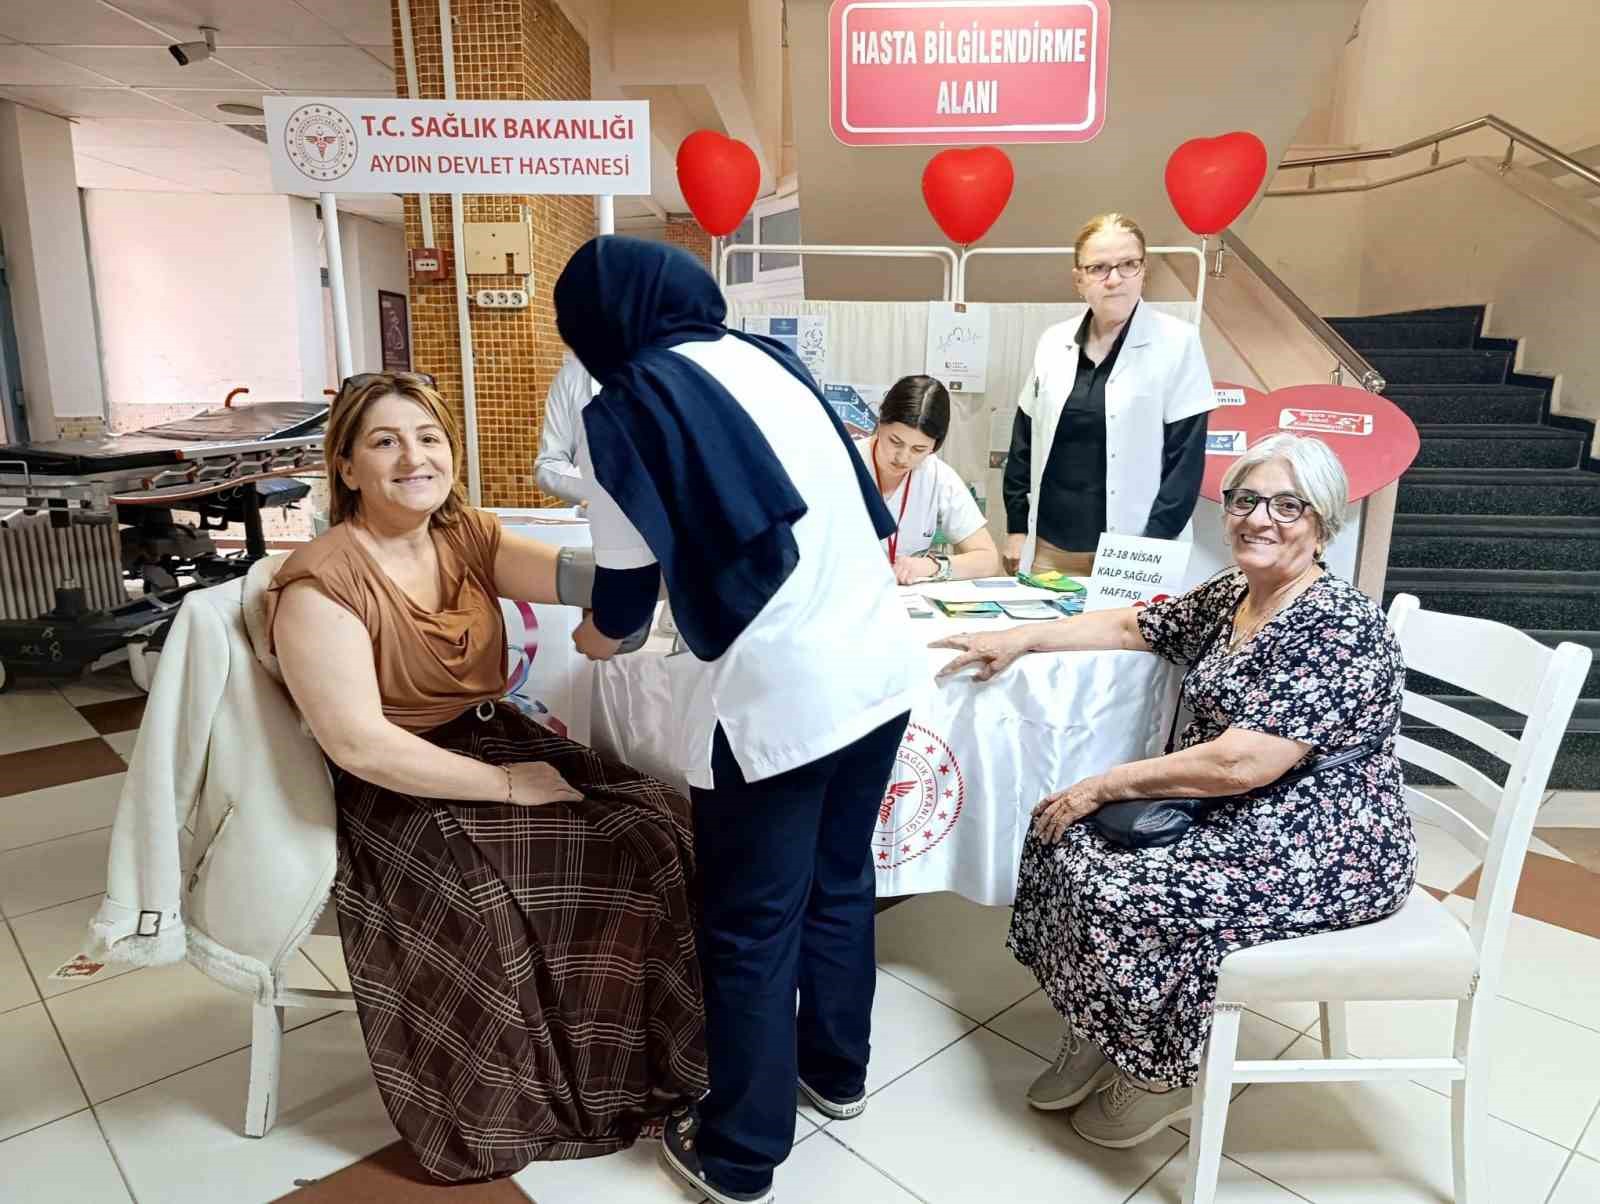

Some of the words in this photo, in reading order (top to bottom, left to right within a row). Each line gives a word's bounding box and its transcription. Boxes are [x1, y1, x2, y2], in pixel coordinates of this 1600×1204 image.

[851, 31, 918, 65] HASTA
[924, 21, 1087, 64] BİLGİLENDİRME
[936, 80, 998, 114] ALANI
[361, 115, 405, 137] T.C.
[411, 113, 497, 138] SAĞLIK
[503, 115, 634, 140] BAKANLIĞI
[370, 155, 432, 173] AYDIN
[438, 156, 514, 174] DEVLET
[519, 154, 630, 176] HASTANESİ
[1102, 548, 1128, 560] 12-18
[1130, 551, 1162, 564] NİSAN
[1097, 567, 1122, 577] KALP
[1122, 570, 1163, 584] SAĞLIĞI
[1099, 586, 1142, 600] HAFTASI
